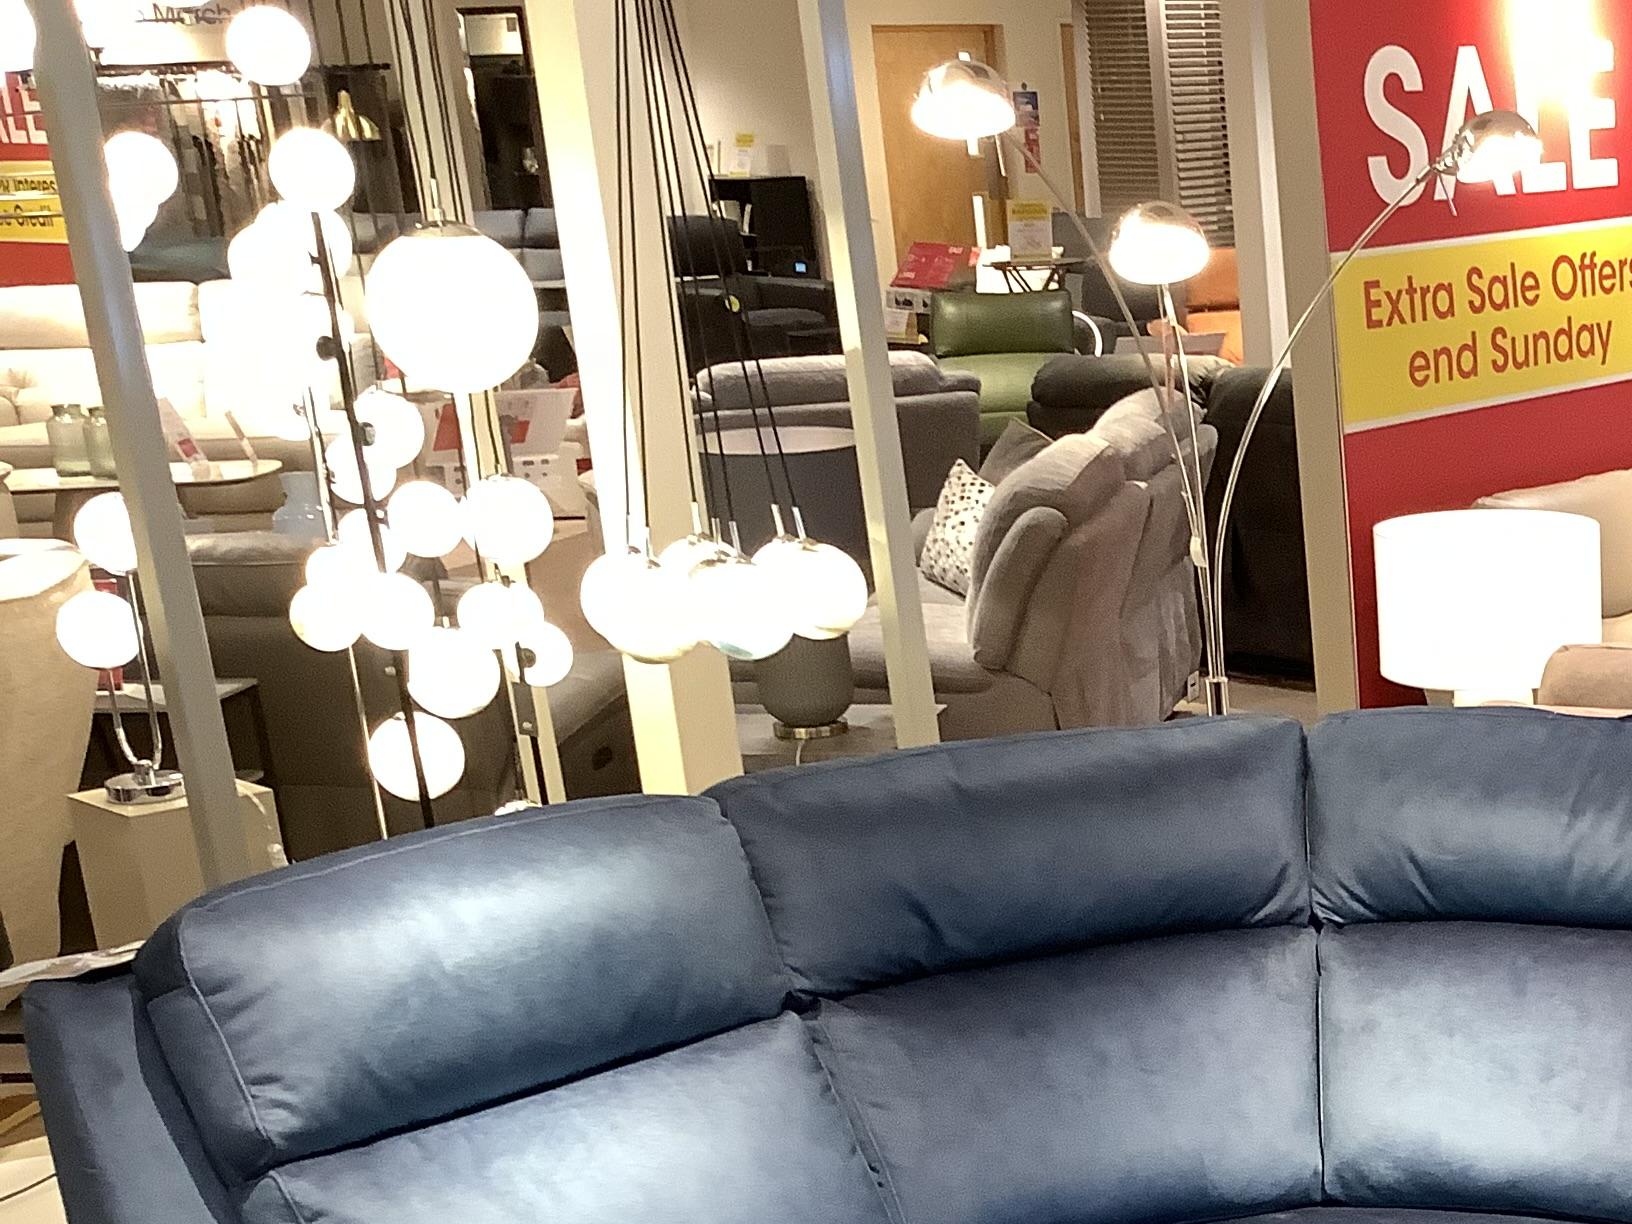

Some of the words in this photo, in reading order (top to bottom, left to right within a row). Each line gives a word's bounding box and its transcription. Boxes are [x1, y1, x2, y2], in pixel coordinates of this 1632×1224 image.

[1363, 277, 1455, 330] Extra
[1467, 261, 1540, 315] Sale
[1409, 332, 1478, 388] end
[1491, 316, 1613, 374] Sunday
